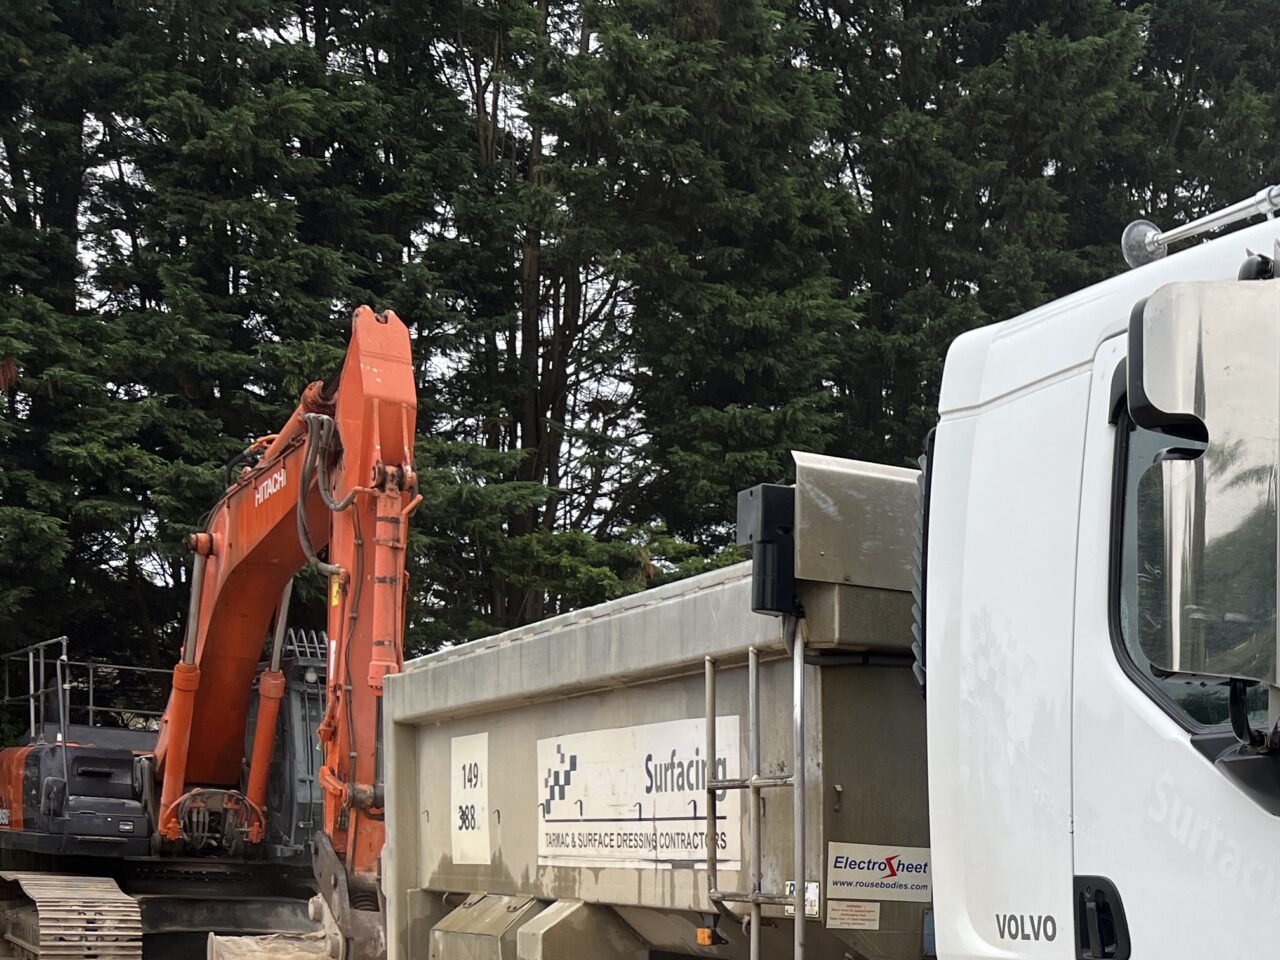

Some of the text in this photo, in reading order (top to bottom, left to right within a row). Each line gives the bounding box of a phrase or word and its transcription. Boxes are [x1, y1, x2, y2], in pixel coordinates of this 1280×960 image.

[255, 468, 287, 508] HITACHI
[462, 762, 479, 790] 149
[545, 832, 570, 848] TARMAC
[571, 832, 577, 848] &
[577, 832, 615, 849] SURFACE
[616, 832, 658, 850] DRESSING
[833, 854, 929, 879] ElectroSheet
[831, 879, 929, 891] www.rousebodies.com
[995, 913, 1057, 942] VOLVO
